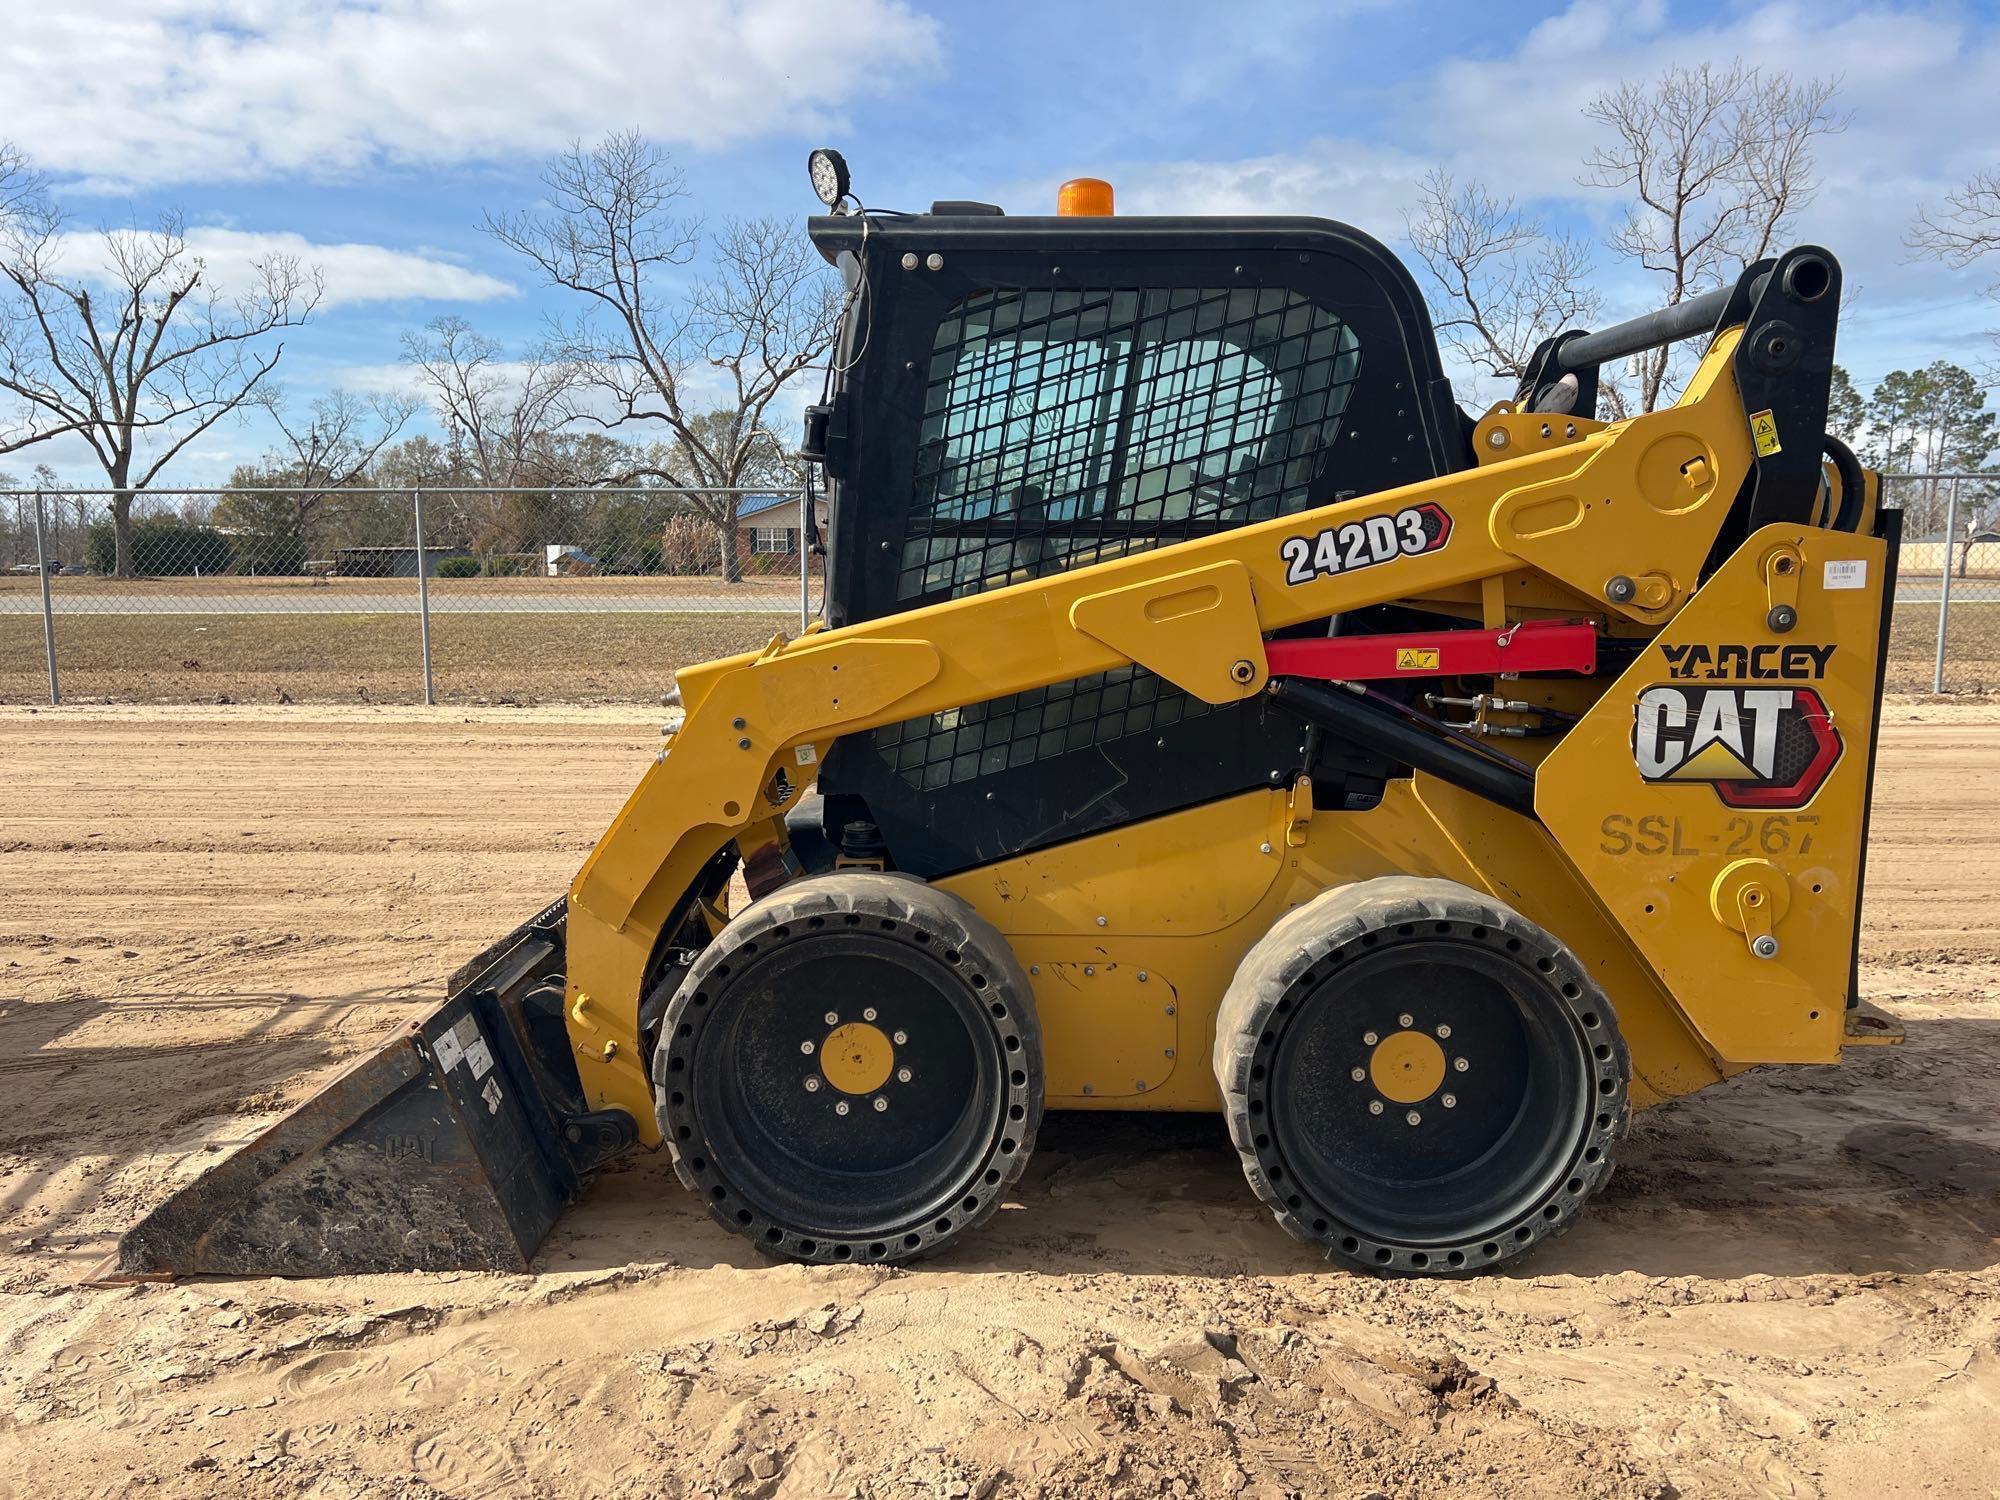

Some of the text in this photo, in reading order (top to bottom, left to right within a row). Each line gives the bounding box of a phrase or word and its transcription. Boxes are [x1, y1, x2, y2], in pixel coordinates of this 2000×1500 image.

[1283, 509, 1427, 583] 242D3
[1660, 644, 1837, 679] YANCEY
[1636, 687, 1793, 779] CAT
[1599, 814, 1821, 856] SSL-267
